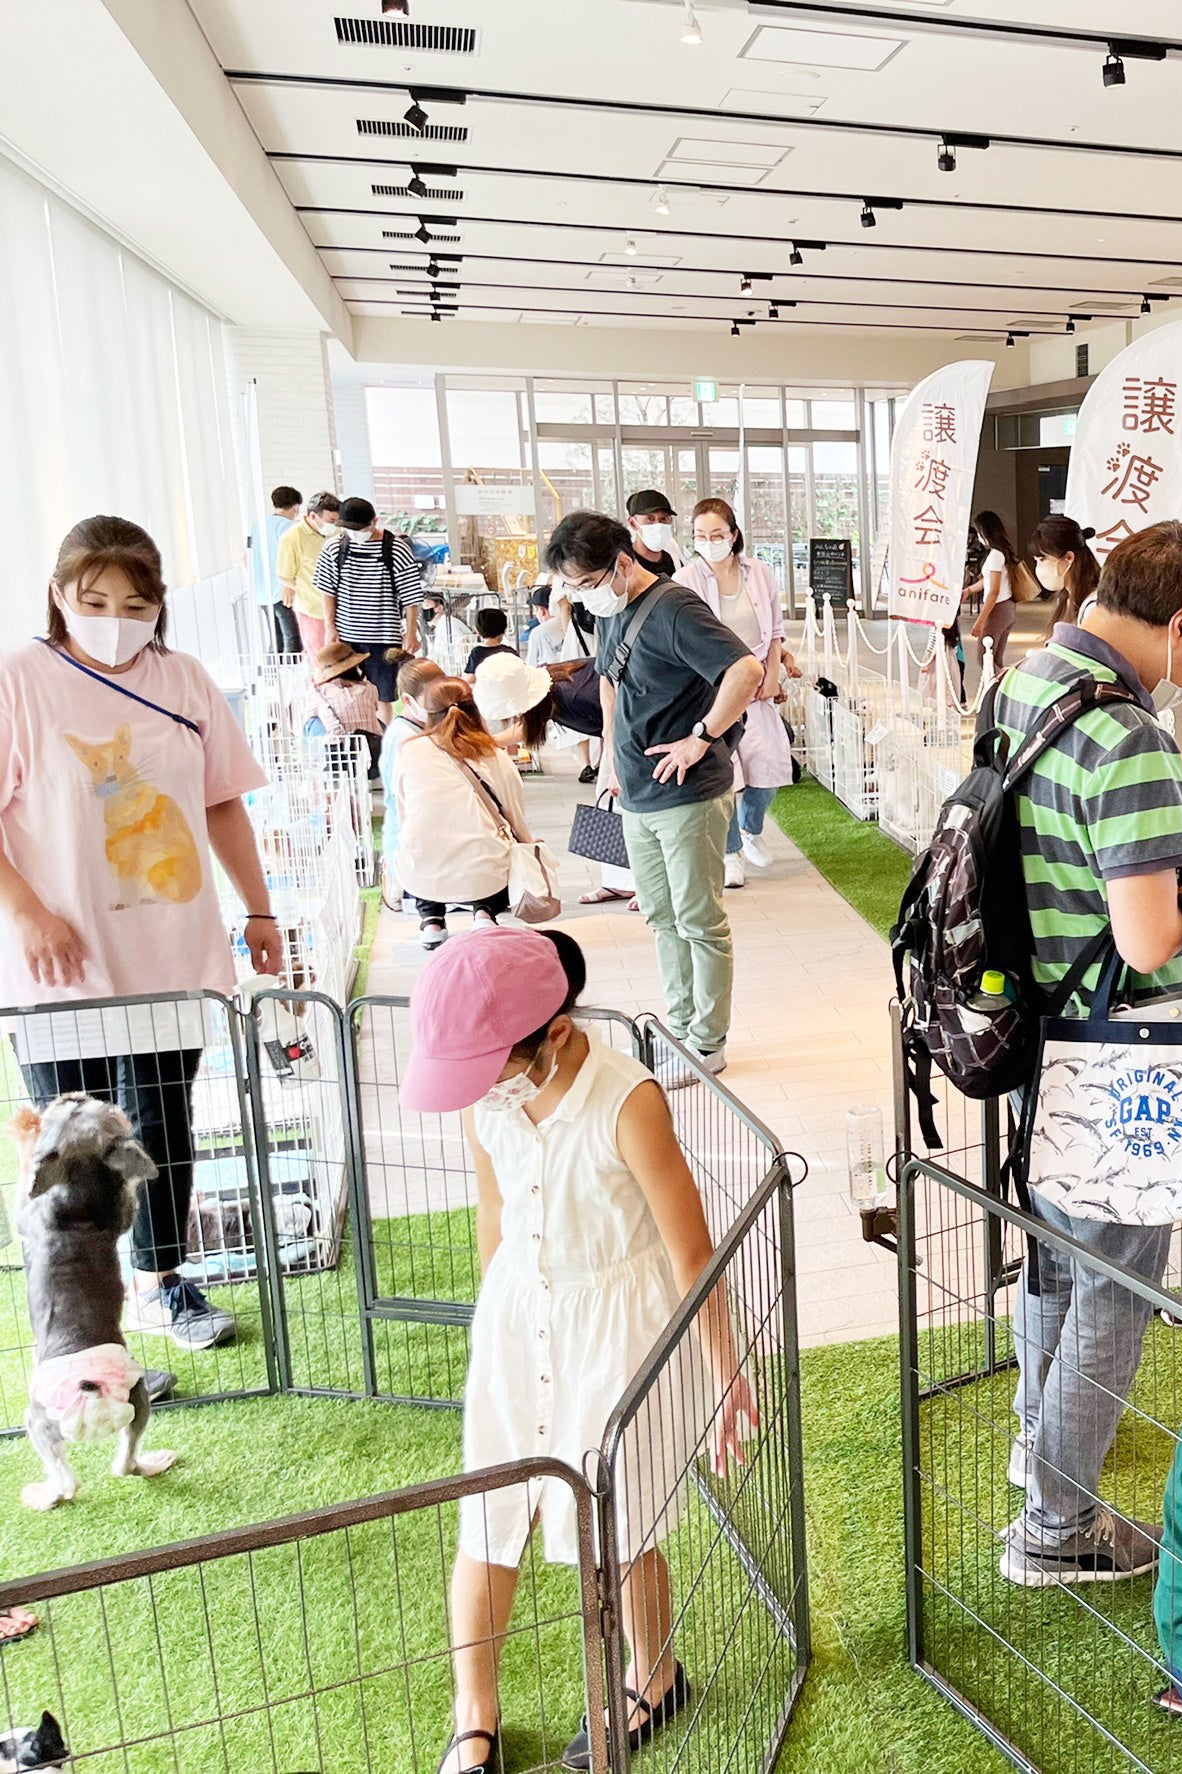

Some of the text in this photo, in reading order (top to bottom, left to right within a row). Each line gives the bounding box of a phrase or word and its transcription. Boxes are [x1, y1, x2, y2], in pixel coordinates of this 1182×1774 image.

[914, 402, 957, 545] 譲渡会
[898, 588, 951, 605] anifare
[1108, 1069, 1182, 1102] ORIGINAL
[1119, 1095, 1171, 1125] GAP
[1124, 1138, 1165, 1158] 1969
